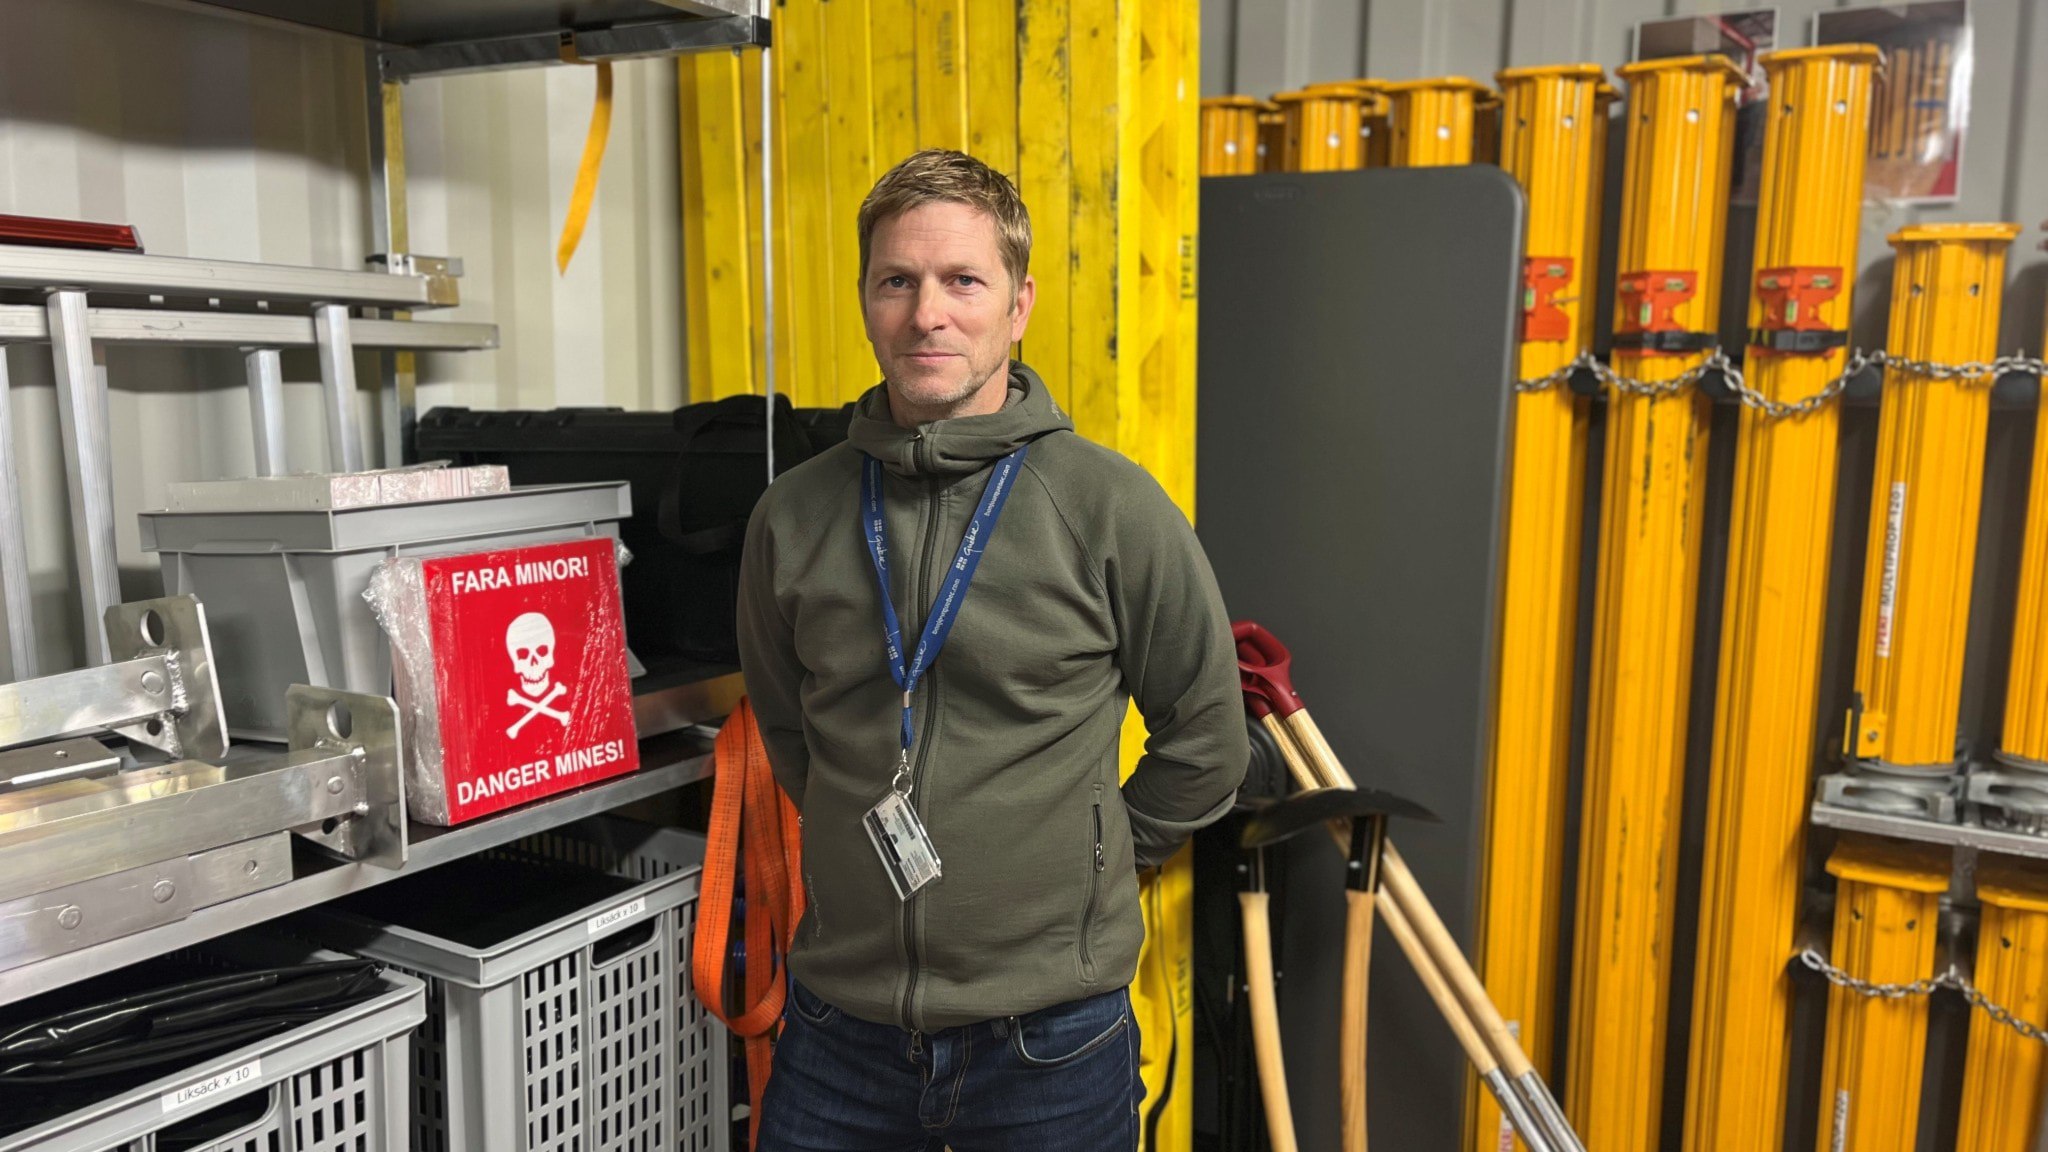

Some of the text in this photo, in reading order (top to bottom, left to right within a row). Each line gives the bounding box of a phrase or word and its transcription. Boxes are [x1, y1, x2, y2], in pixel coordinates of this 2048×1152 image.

[452, 556, 589, 595] FARA MINOR!
[456, 739, 625, 806] DANGER MINES!
[629, 902, 639, 914] 10
[224, 1075, 232, 1085] x
[235, 1066, 250, 1081] 10
